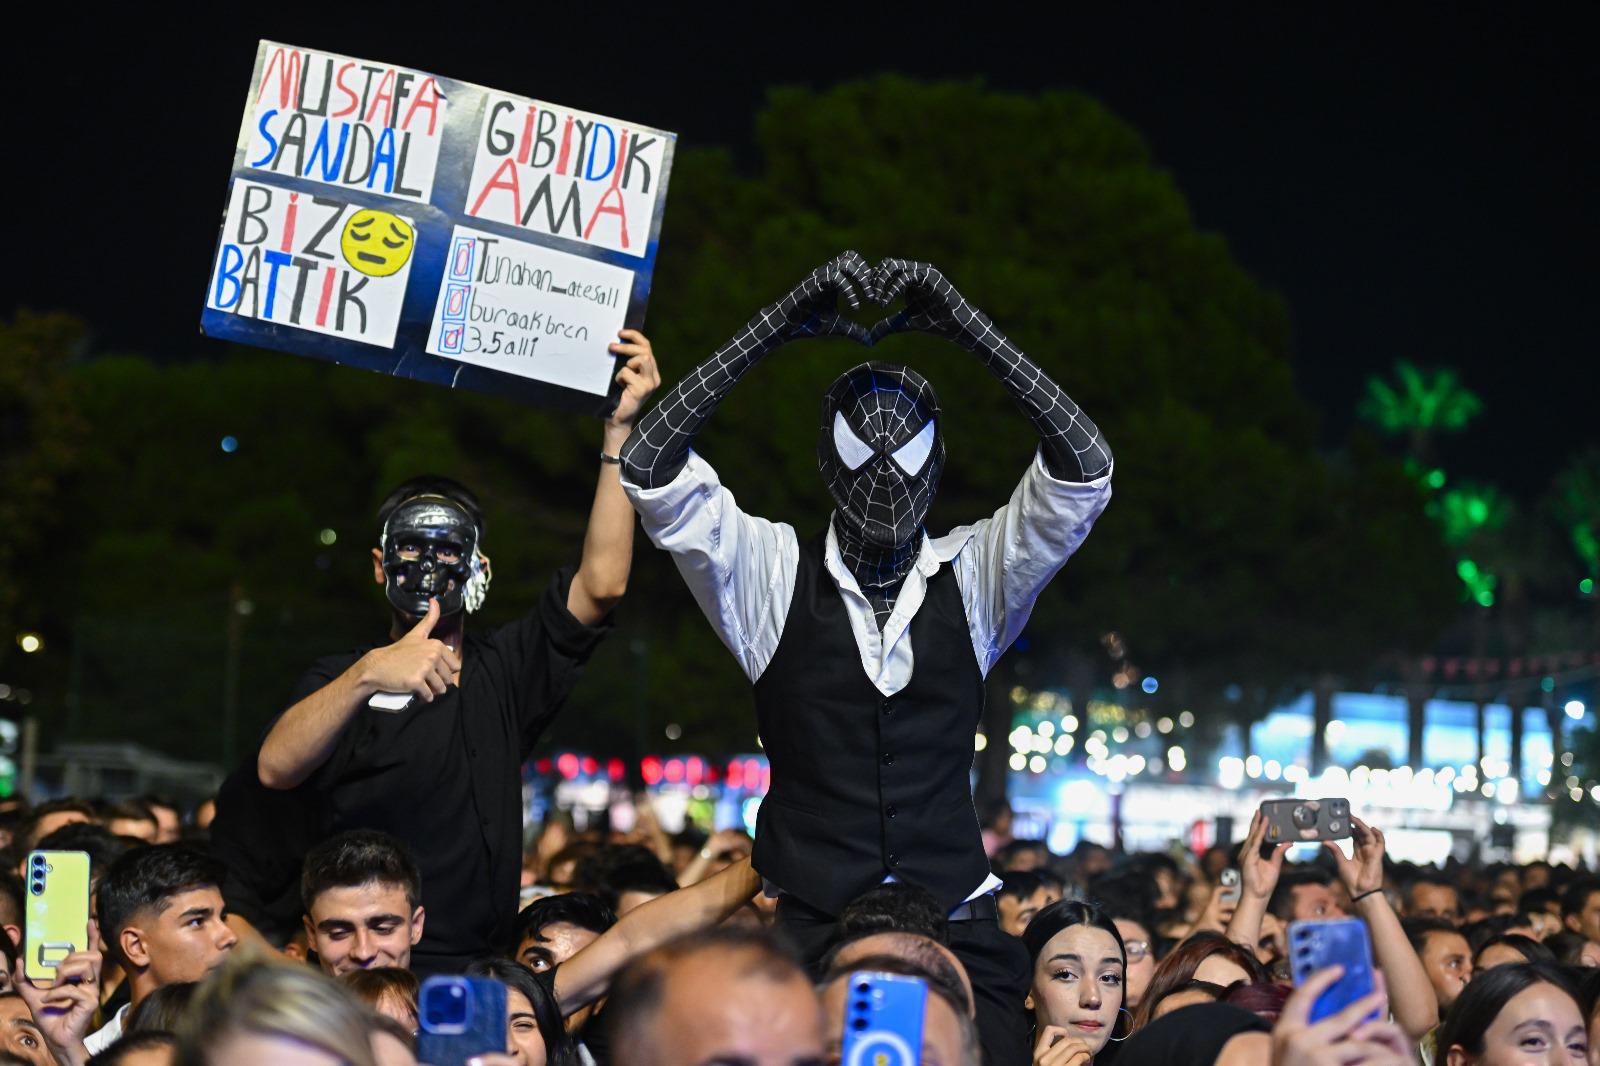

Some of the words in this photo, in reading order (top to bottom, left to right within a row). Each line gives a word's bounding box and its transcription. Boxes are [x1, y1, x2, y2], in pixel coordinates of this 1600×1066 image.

[257, 48, 441, 136] MUSTAFA
[252, 109, 422, 198] SANDAL
[469, 158, 629, 249] AMA
[214, 244, 369, 334] BATTIK
